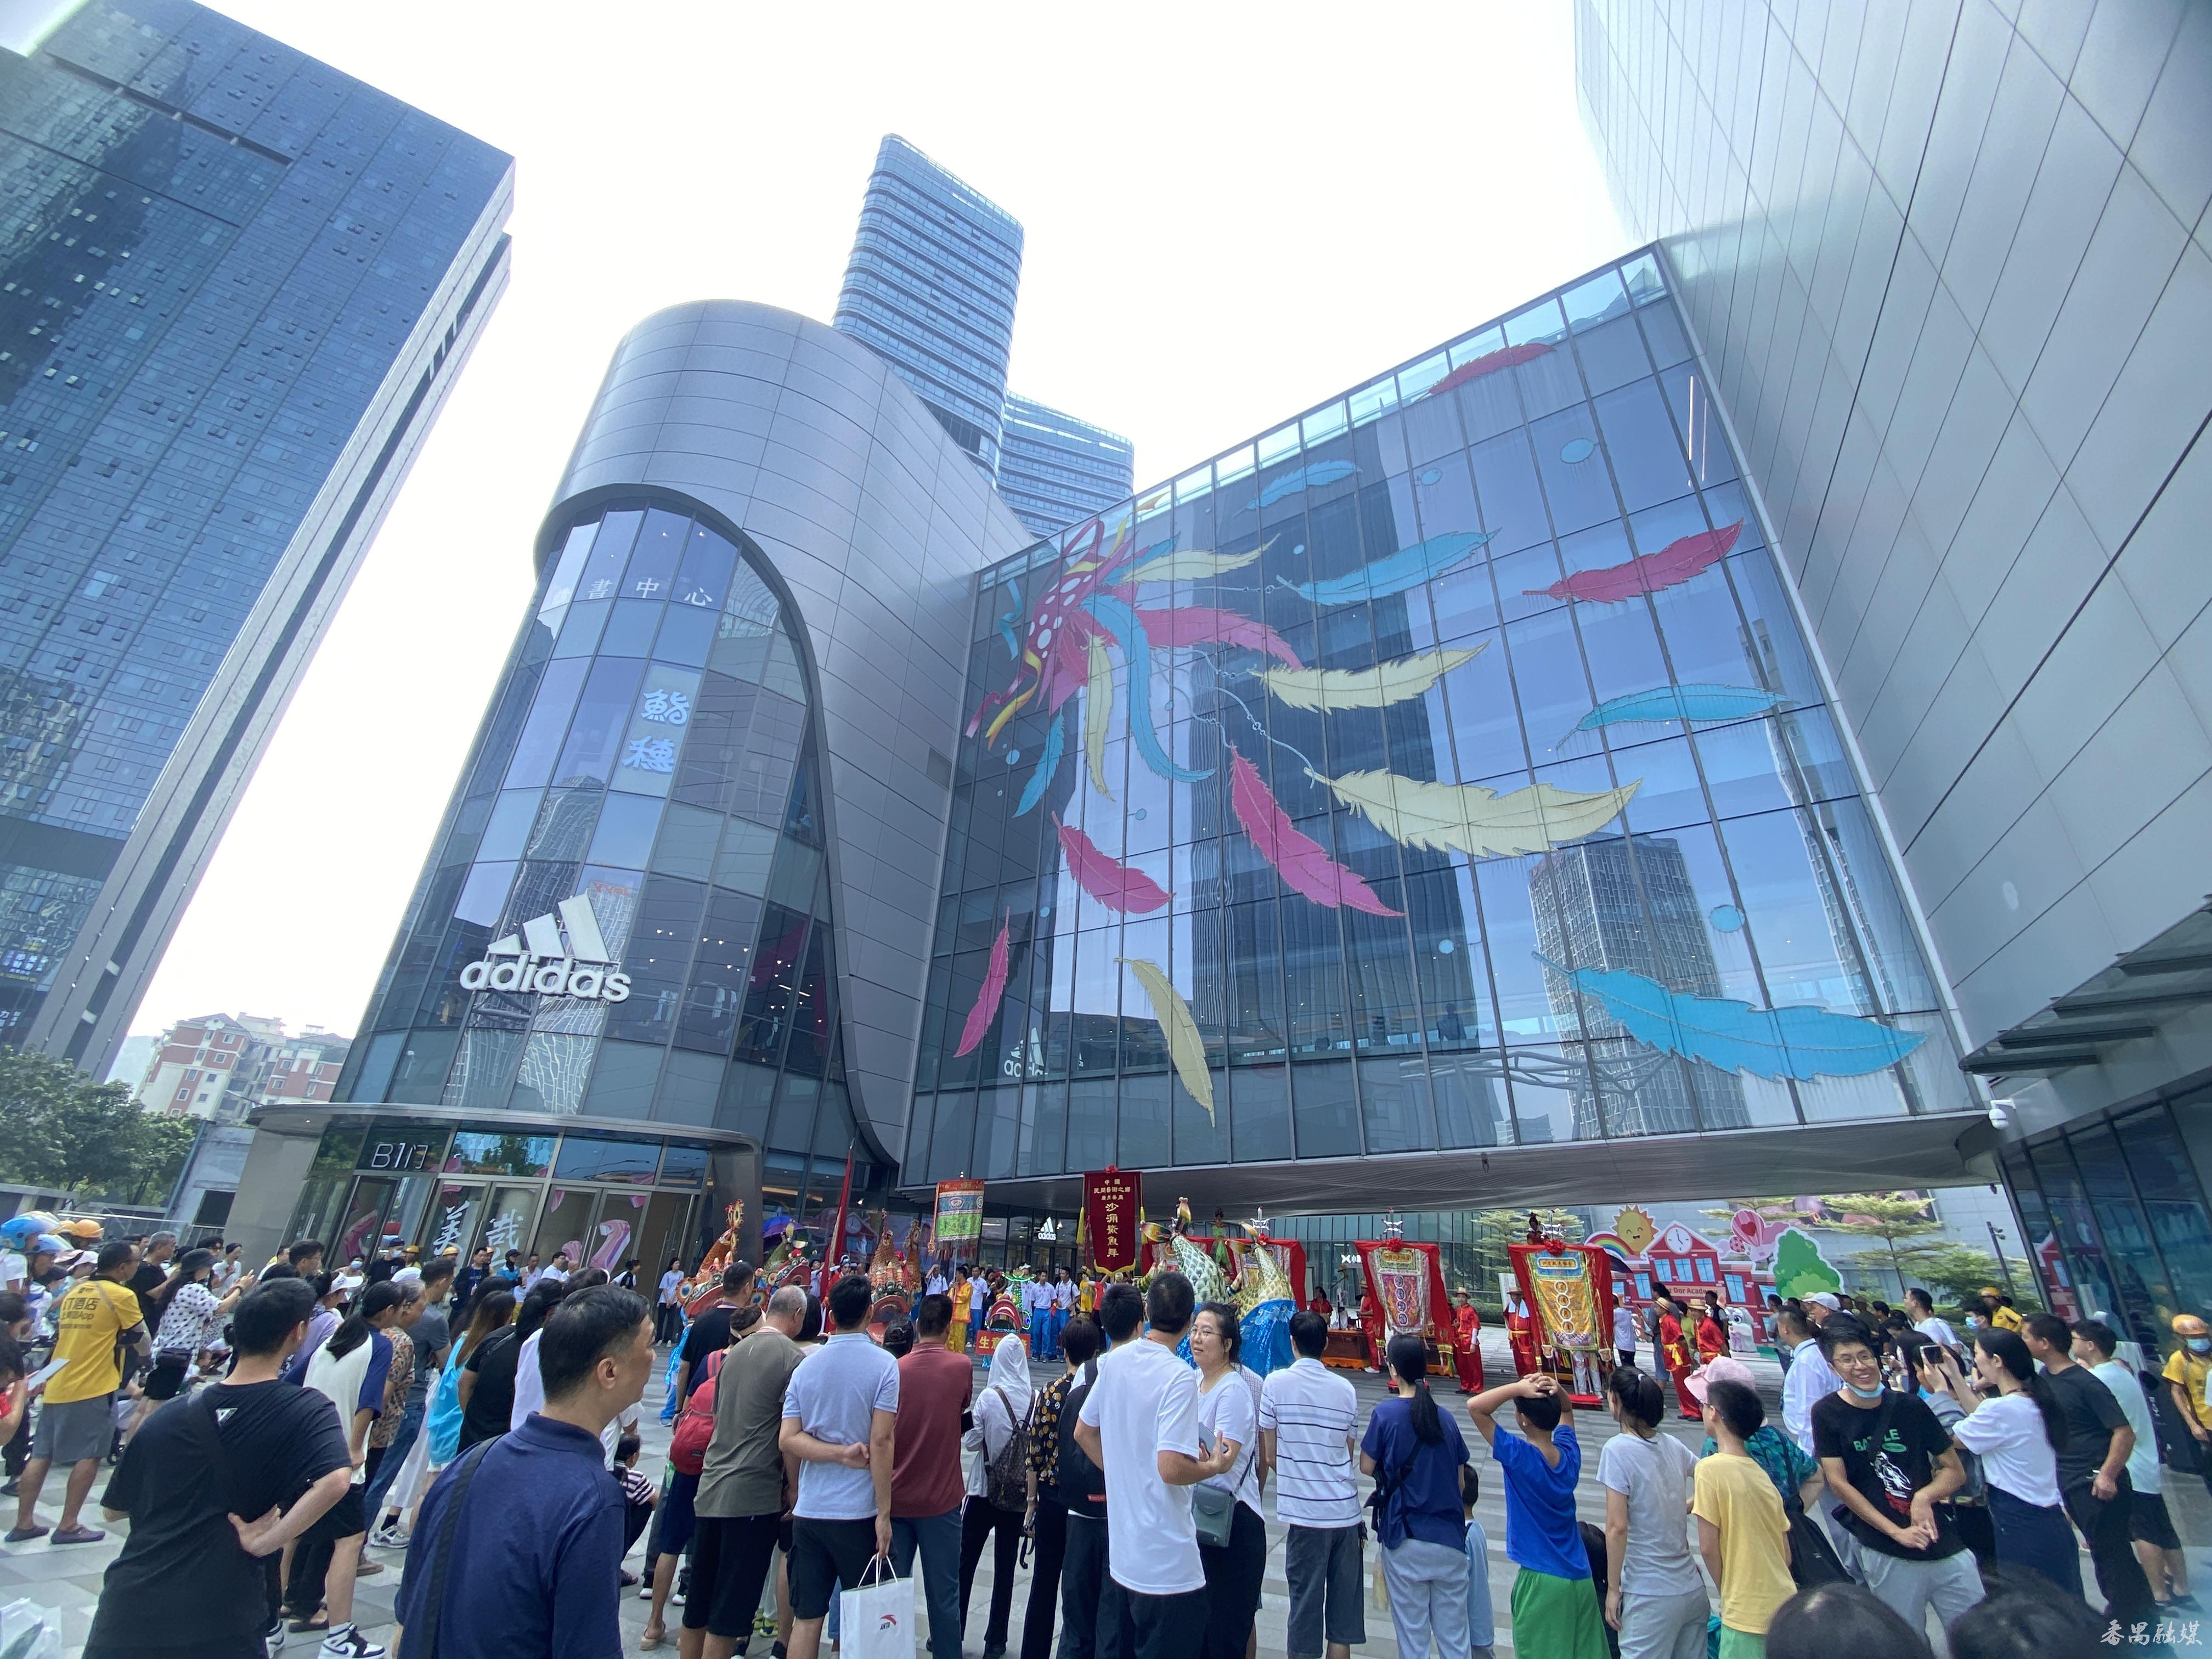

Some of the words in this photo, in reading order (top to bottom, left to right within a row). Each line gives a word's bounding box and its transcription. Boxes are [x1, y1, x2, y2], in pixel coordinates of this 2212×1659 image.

[459, 953, 631, 1002] adidas
[1037, 1232, 1057, 1241] adidas
[1853, 1429, 1901, 1452] BALE
